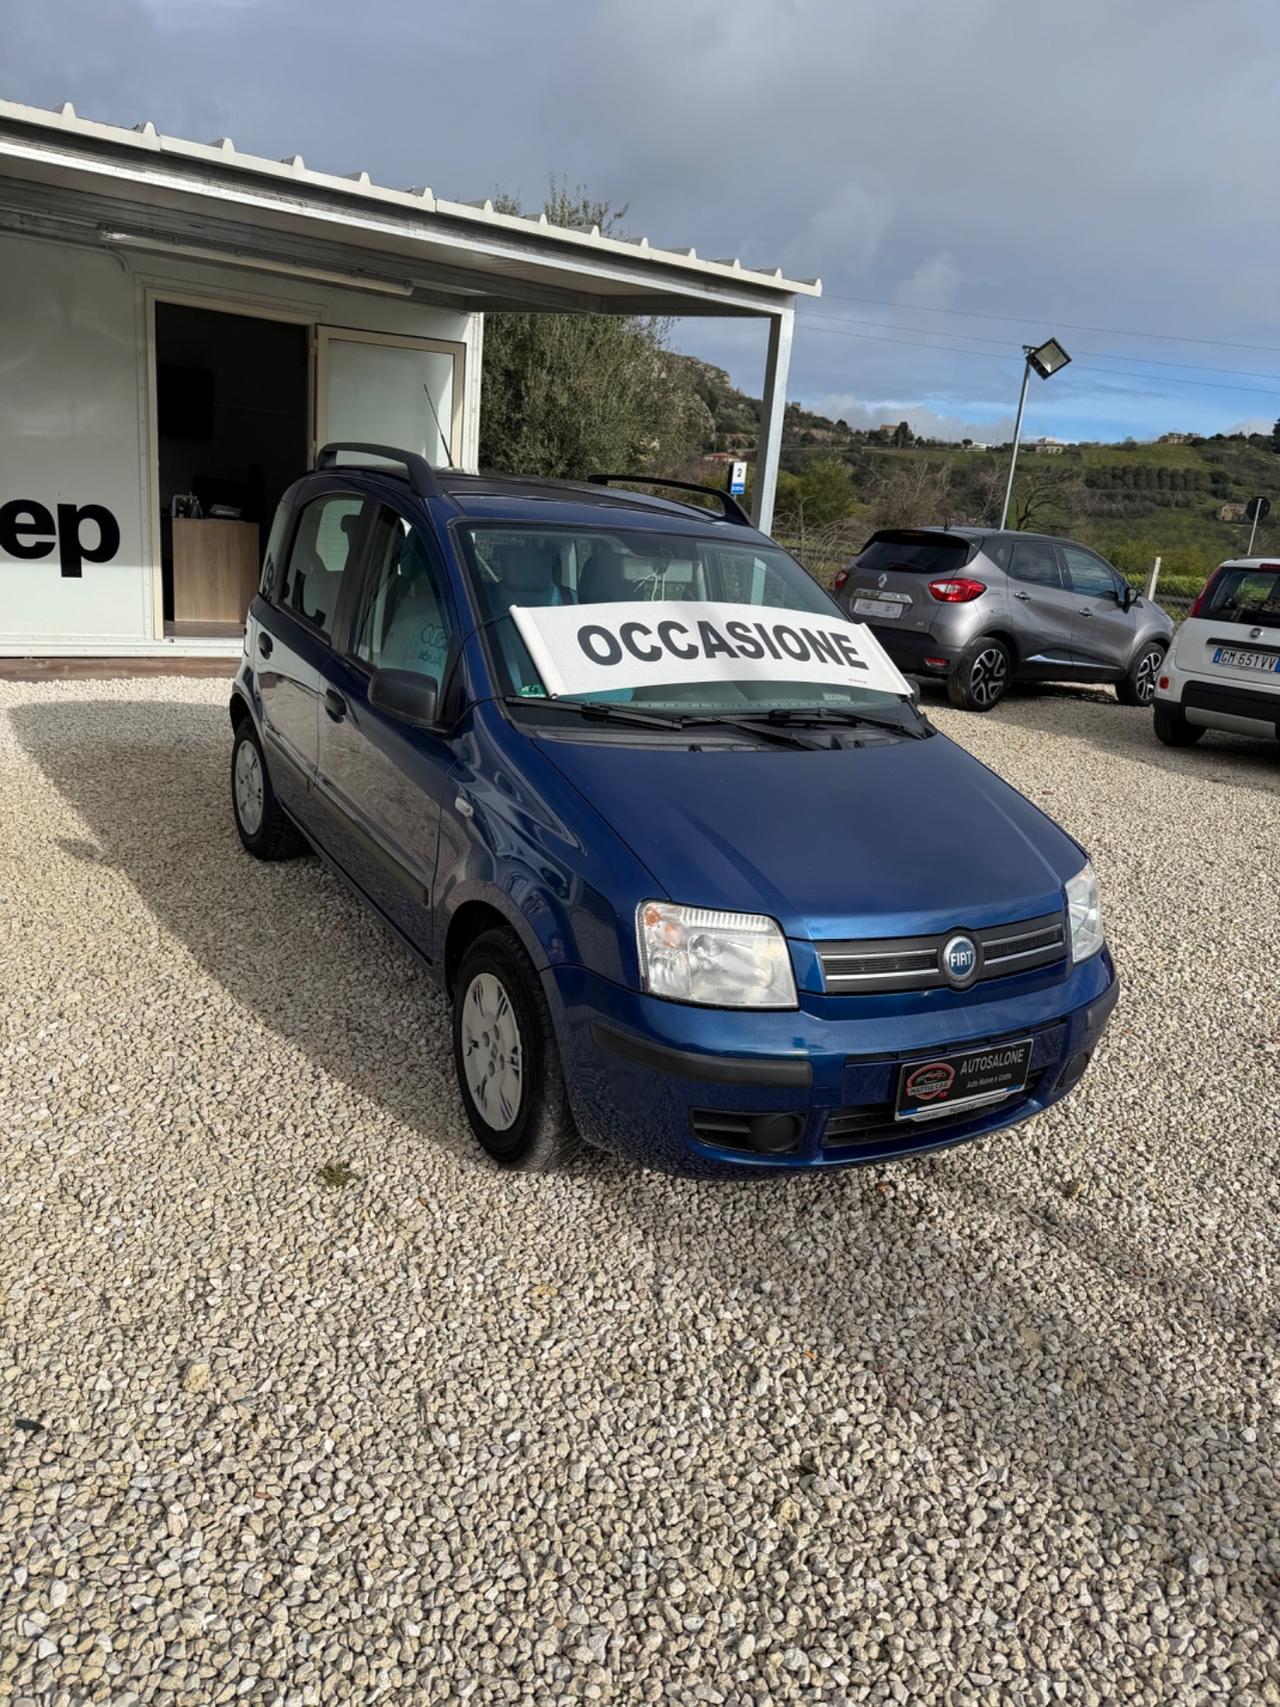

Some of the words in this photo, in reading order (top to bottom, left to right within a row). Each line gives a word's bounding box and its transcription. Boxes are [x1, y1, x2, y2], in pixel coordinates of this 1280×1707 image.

[0, 498, 121, 578] ep
[576, 620, 870, 670] OCCASIONE
[950, 950, 973, 968] FIAT
[960, 1048, 1025, 1075] AUTOSALONE
[934, 1081, 949, 1091] CAR
